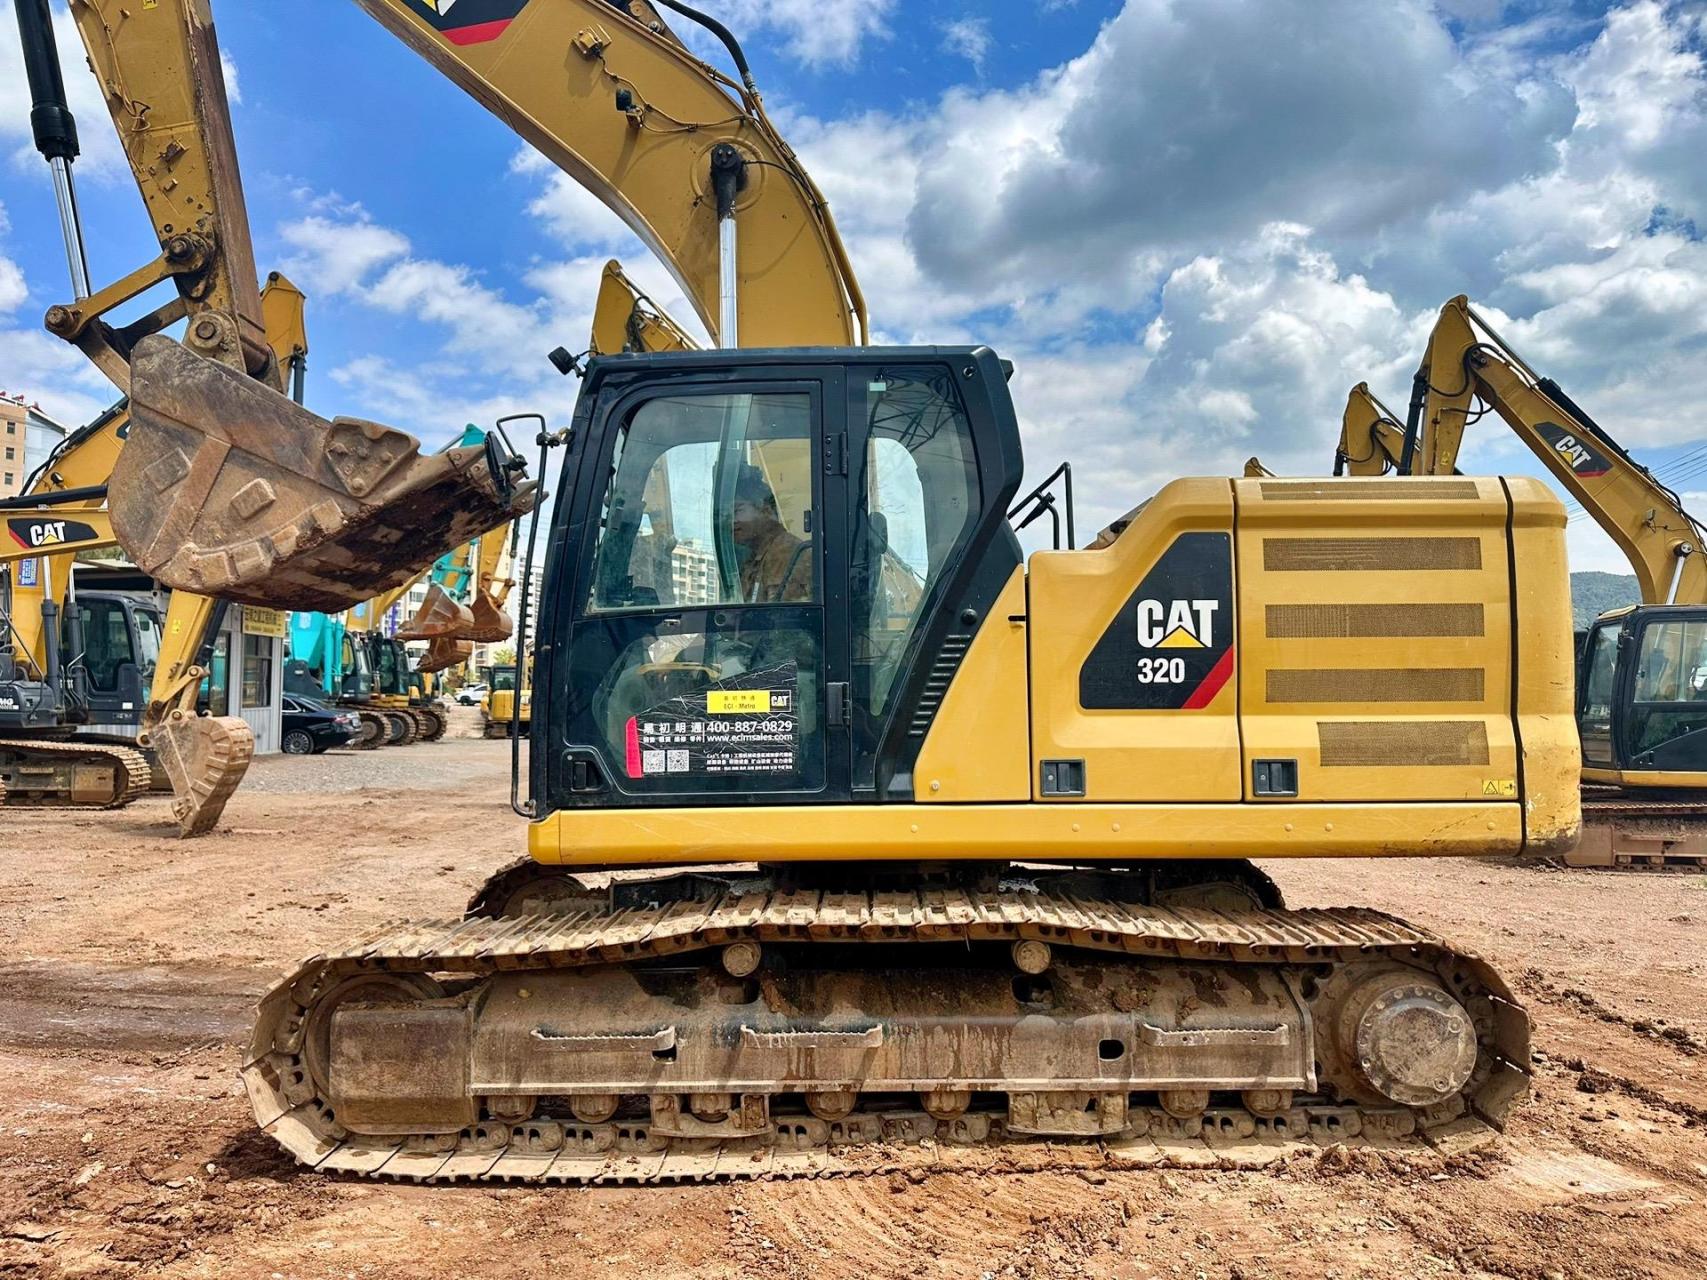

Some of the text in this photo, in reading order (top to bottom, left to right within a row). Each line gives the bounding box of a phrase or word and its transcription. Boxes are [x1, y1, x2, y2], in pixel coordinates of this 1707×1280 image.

[1555, 435, 1592, 468] CAT
[30, 521, 66, 546] CAT
[1137, 599, 1219, 648] CAT
[1137, 657, 1185, 684] 320
[771, 696, 789, 707] CAT
[706, 720, 793, 733] 400-887-0829
